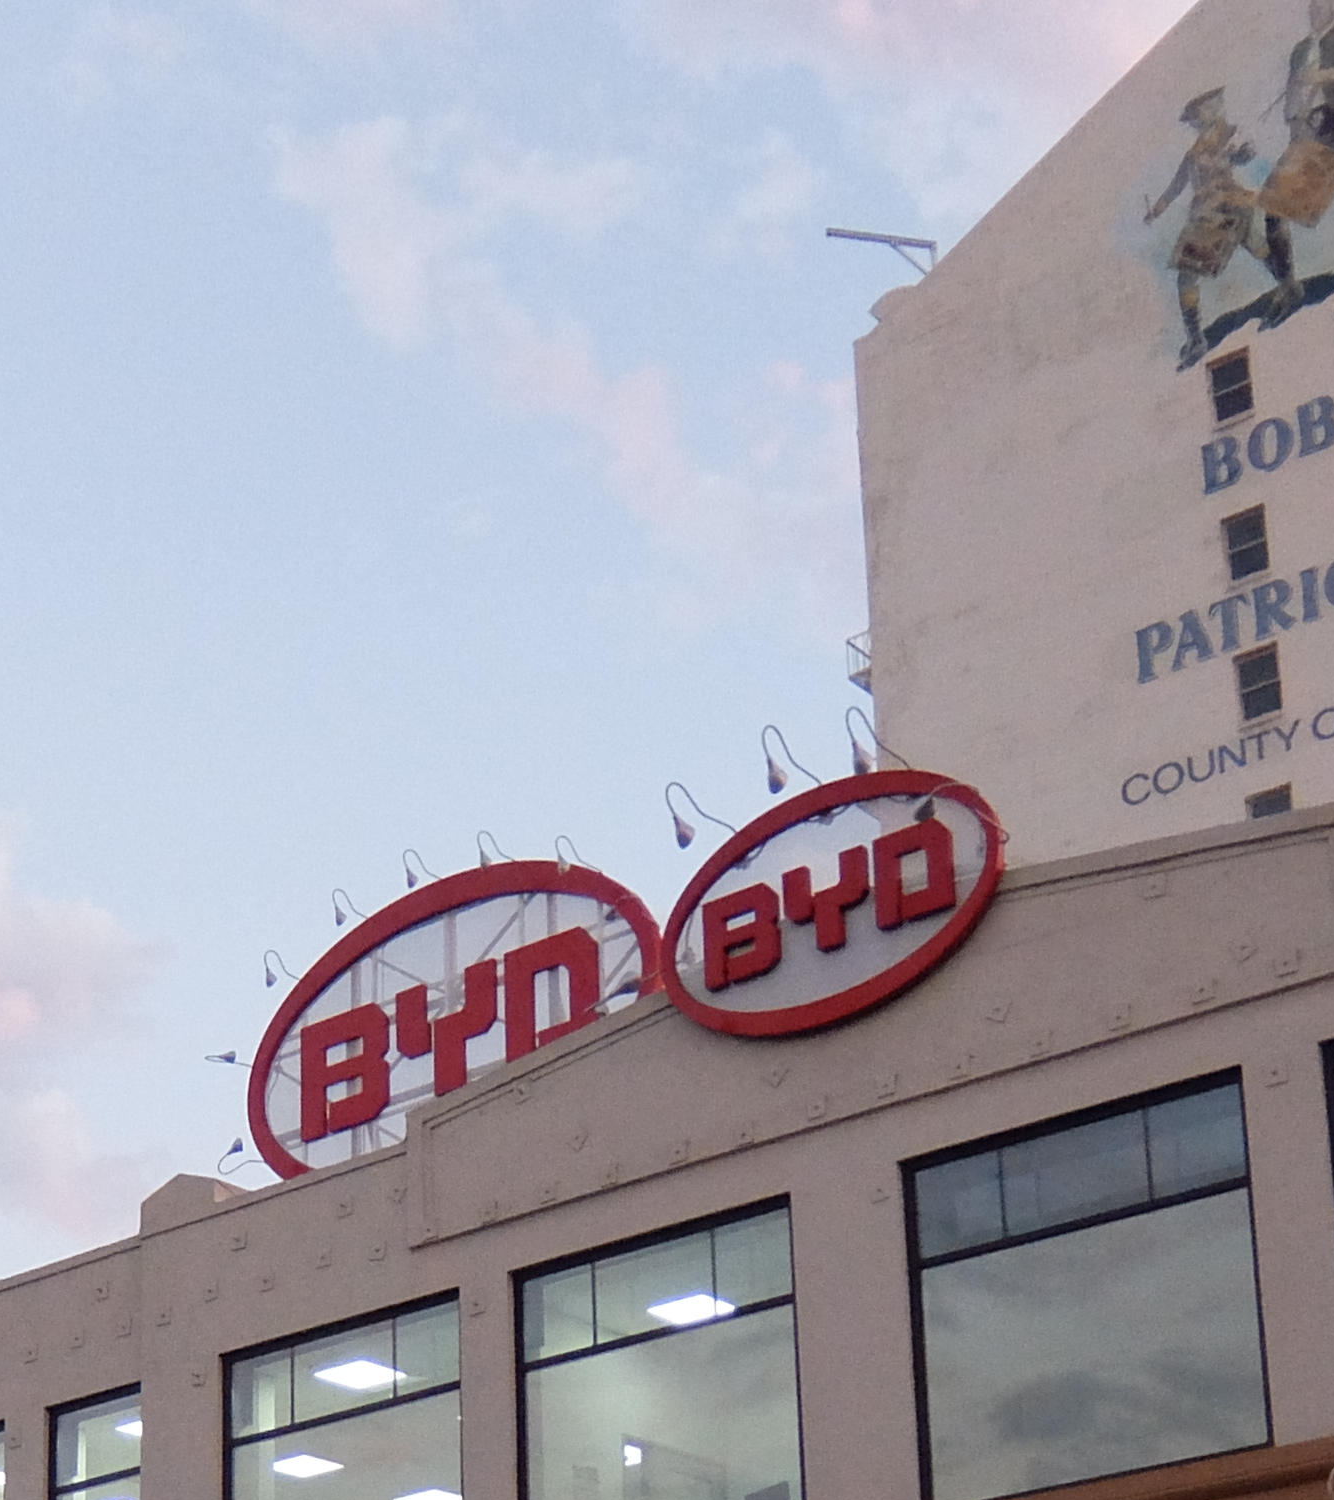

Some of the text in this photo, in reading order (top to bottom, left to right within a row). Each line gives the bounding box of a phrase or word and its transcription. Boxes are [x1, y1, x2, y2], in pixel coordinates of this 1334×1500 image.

[1120, 720, 1301, 806] COUNTY
[702, 818, 956, 992] BYD
[300, 926, 600, 1142] BYD
